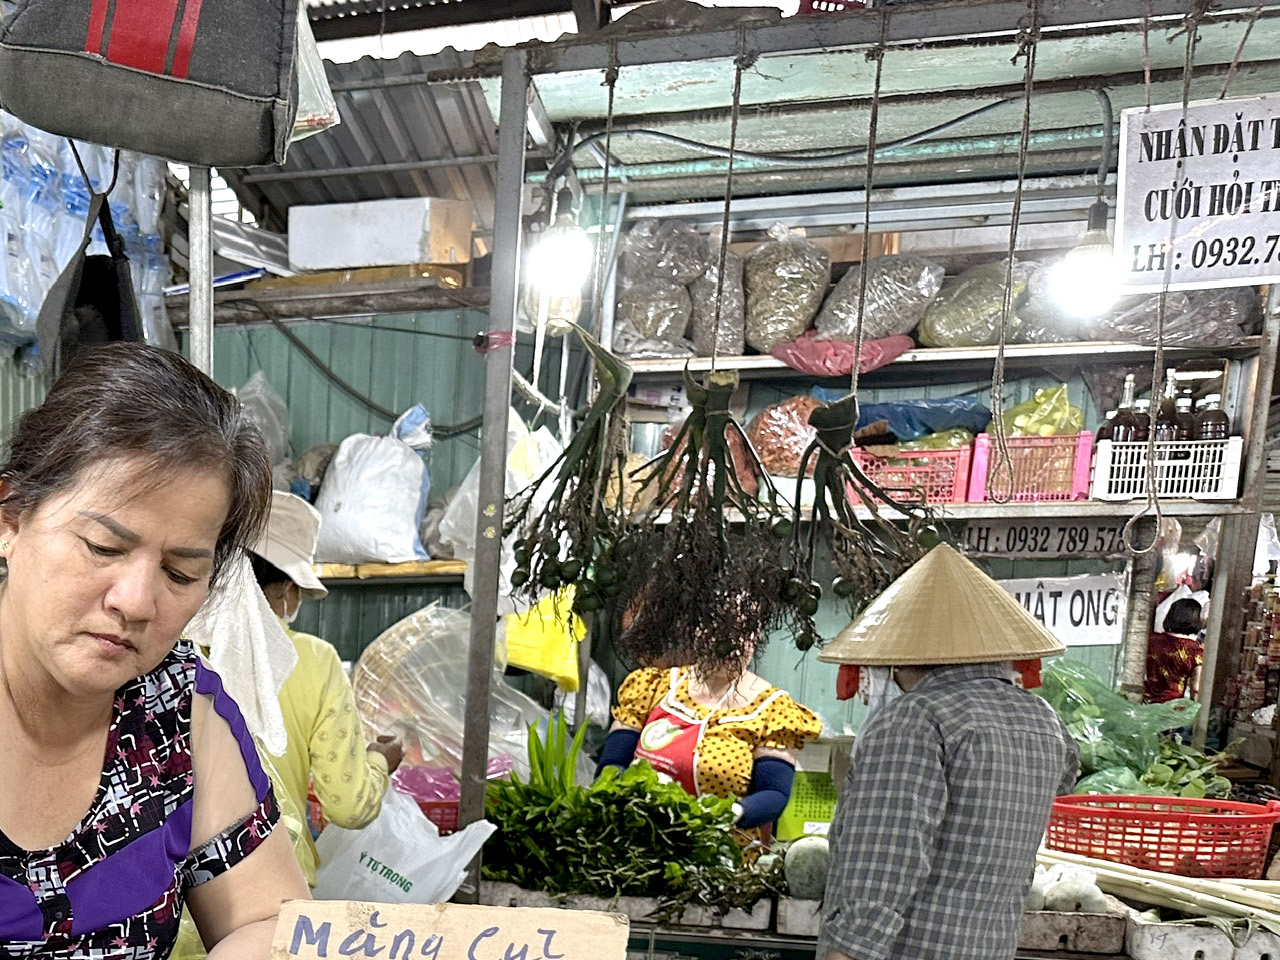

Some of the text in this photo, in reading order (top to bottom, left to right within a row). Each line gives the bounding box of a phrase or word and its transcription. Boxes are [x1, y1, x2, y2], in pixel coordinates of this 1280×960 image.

[1138, 118, 1207, 168] NHẬN
[1212, 112, 1264, 162] ĐẶT
[1144, 177, 1203, 222] CƯỚI
[1207, 169, 1255, 216] HỎI
[1191, 234, 1280, 270] 0932.7
[1006, 526, 1050, 552] 0932
[1056, 527, 1089, 552] 789
[1069, 587, 1119, 627] ONG
[378, 865, 413, 894] TRỌNG
